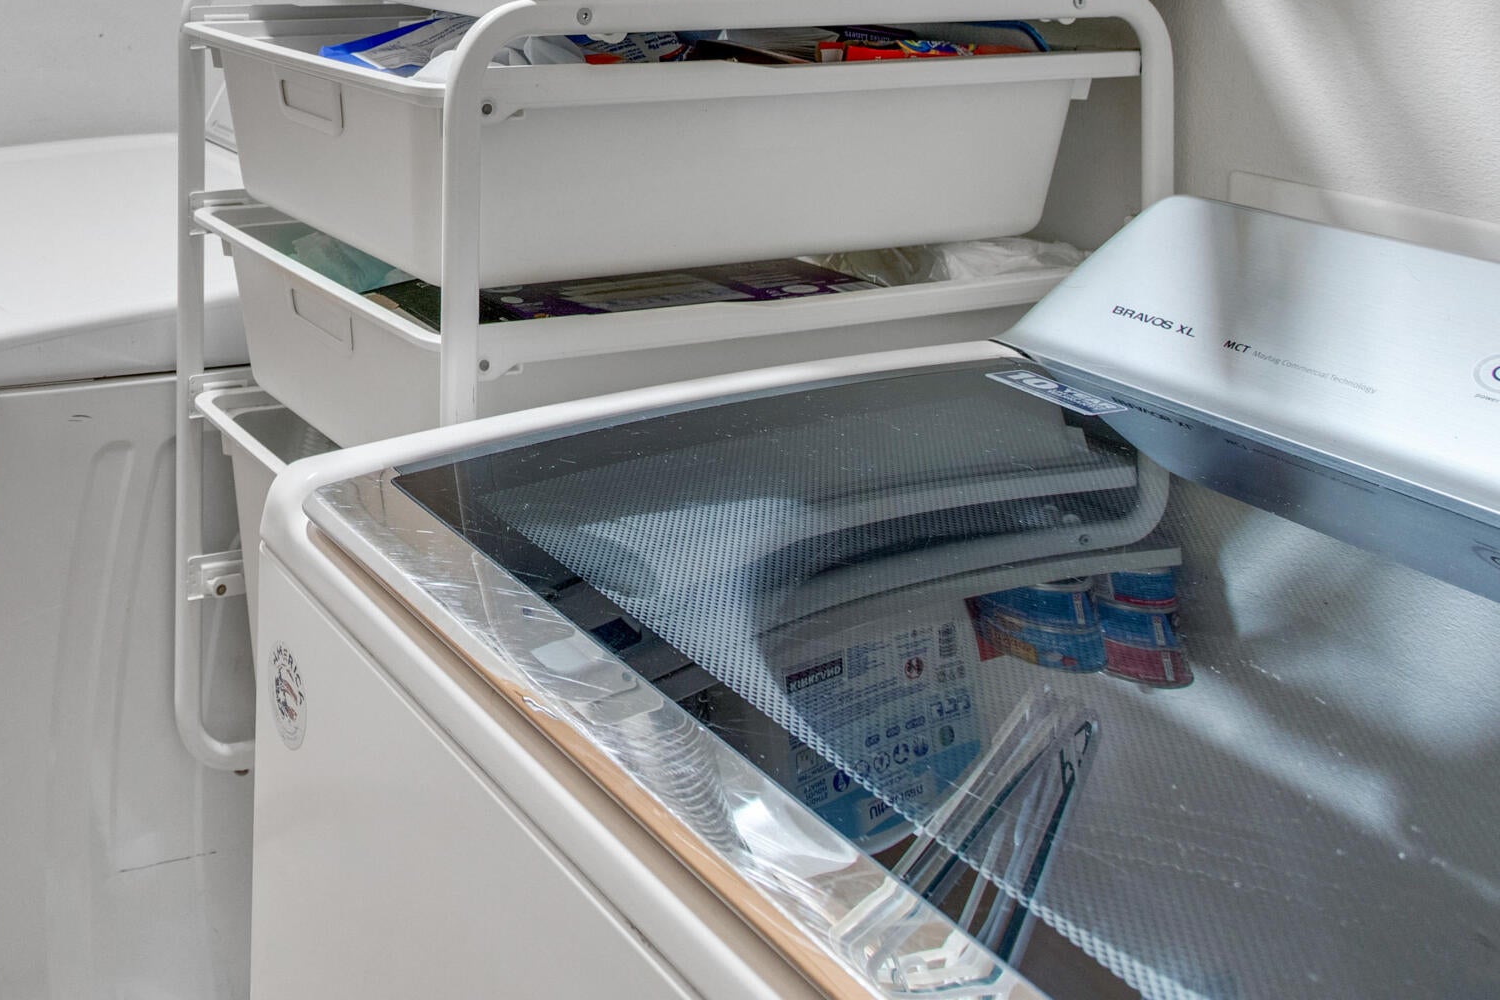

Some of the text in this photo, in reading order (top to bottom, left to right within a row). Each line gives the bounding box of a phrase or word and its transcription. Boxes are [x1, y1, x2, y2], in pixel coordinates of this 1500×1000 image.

[1112, 305, 1196, 338] BRAVOS XL
[1223, 340, 1252, 353] MCT
[1252, 350, 1281, 365] Maytag
[1330, 373, 1378, 394] Technology
